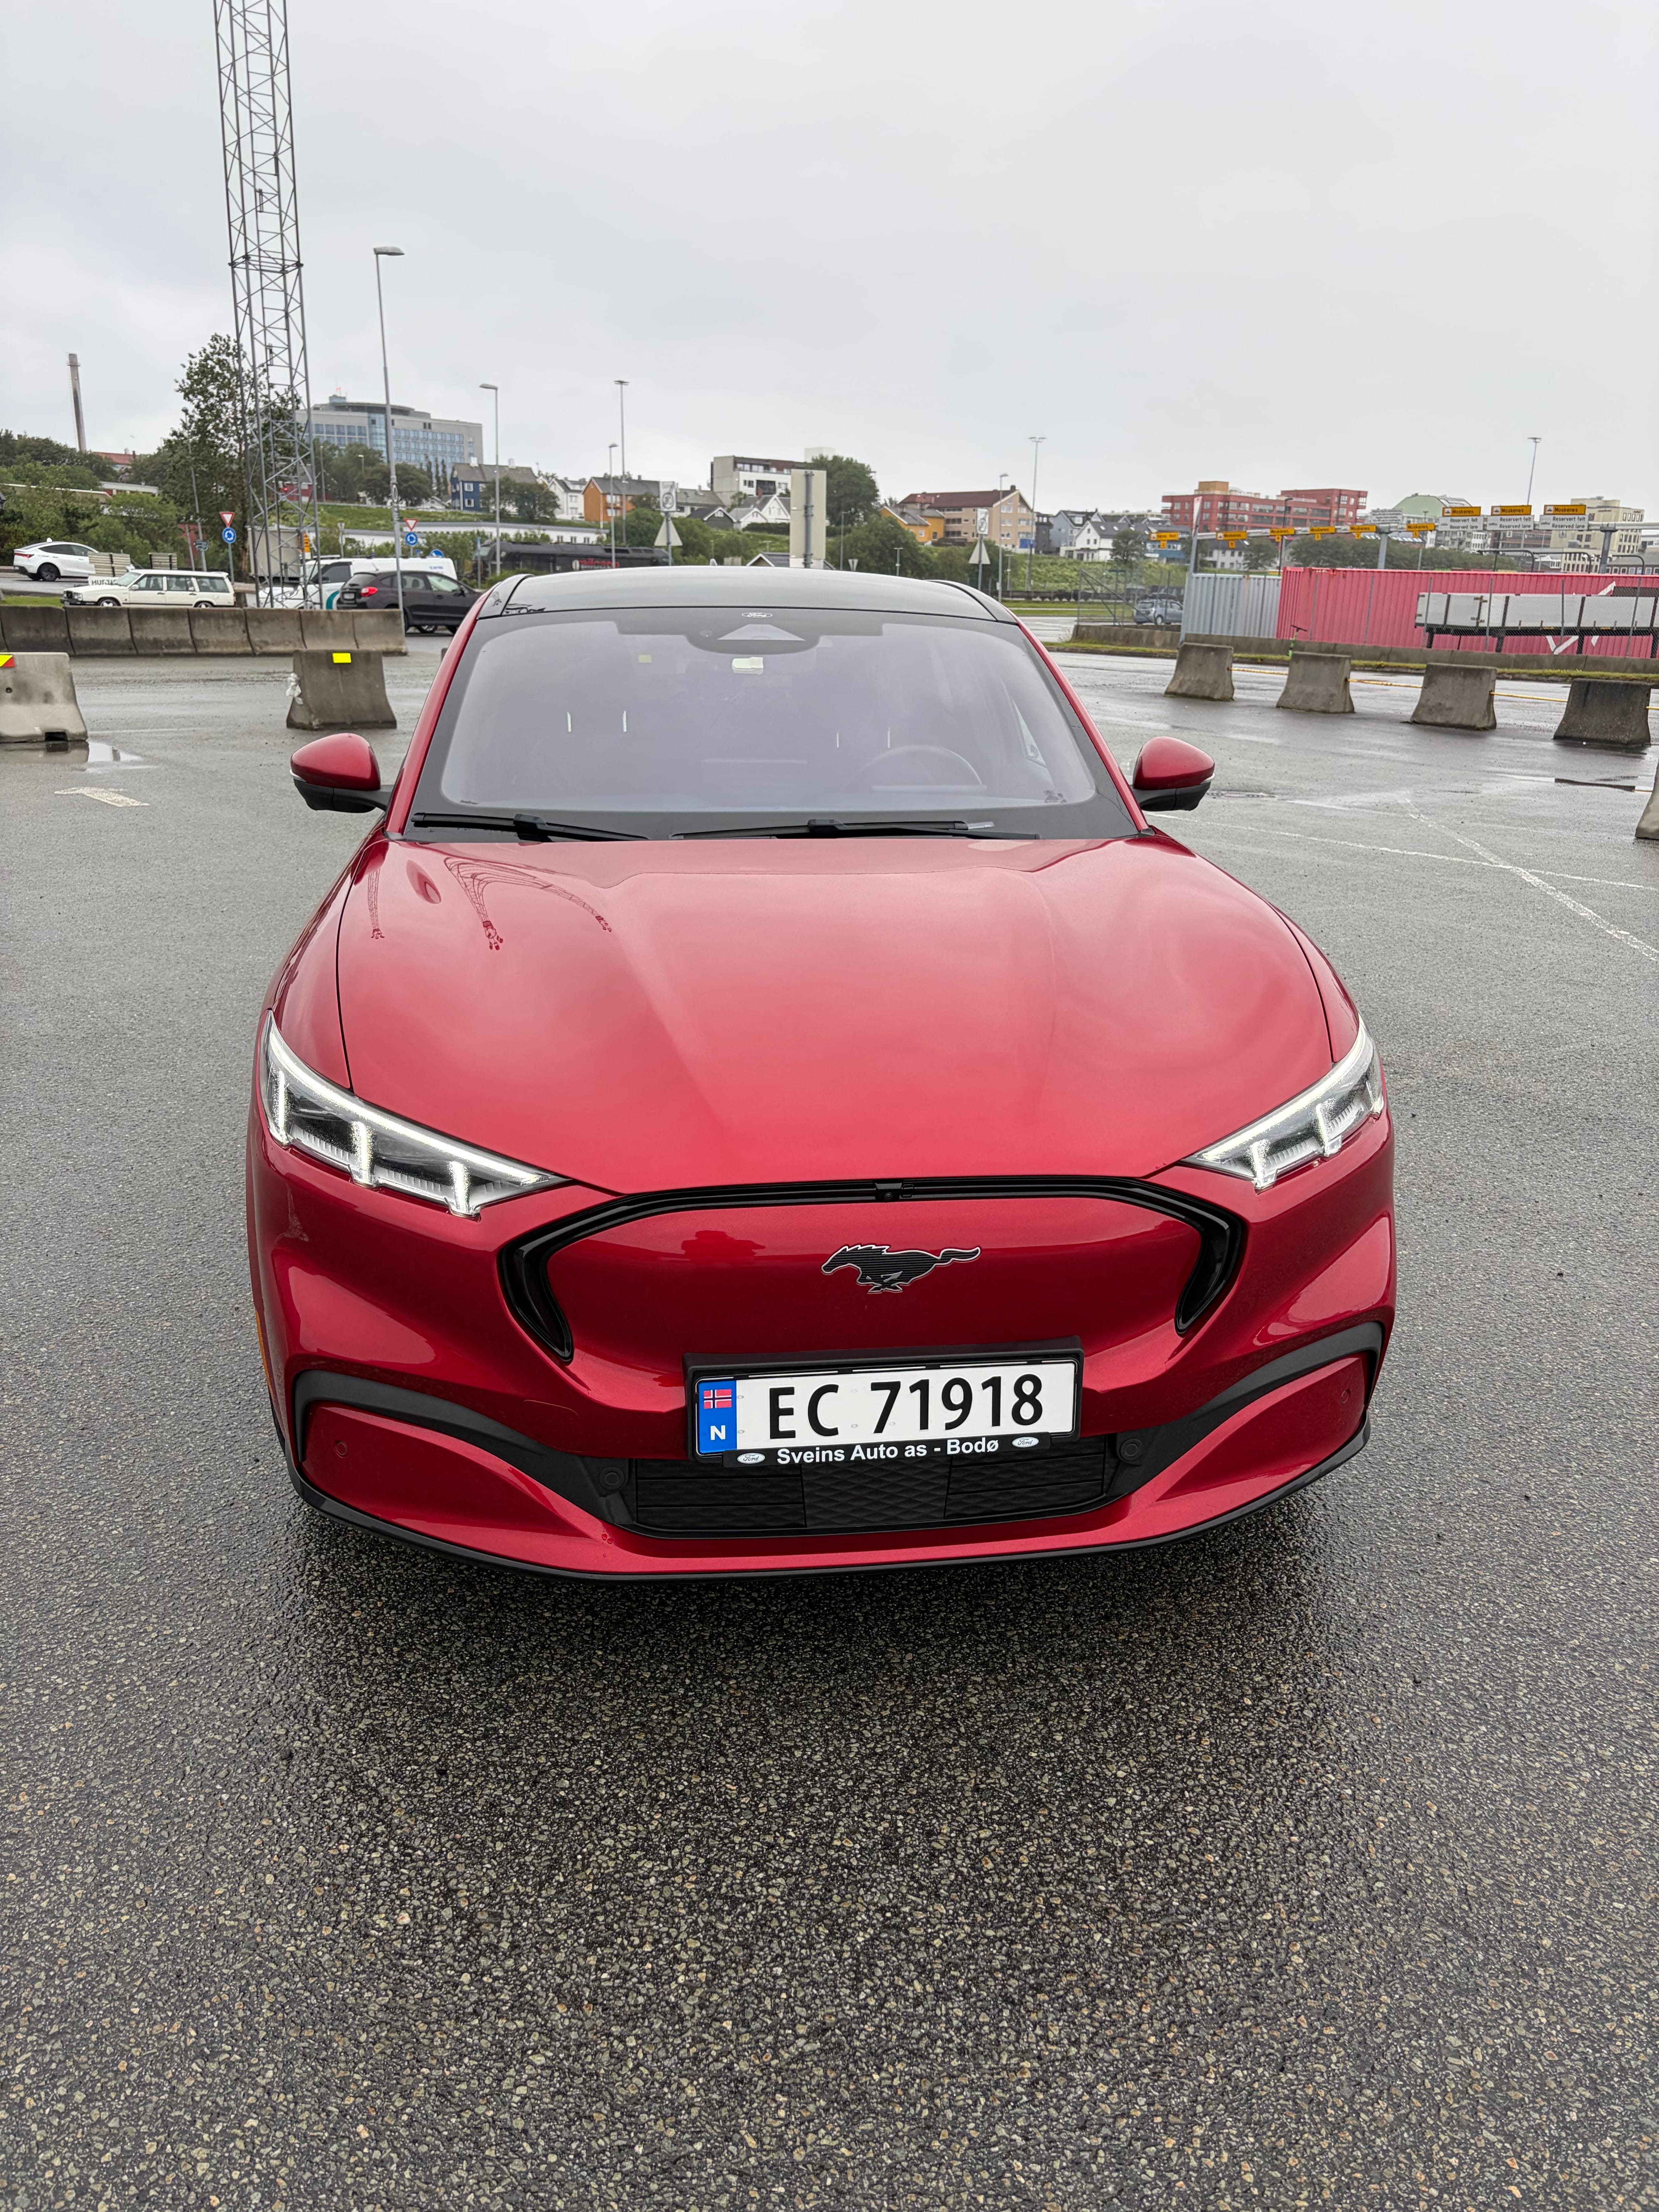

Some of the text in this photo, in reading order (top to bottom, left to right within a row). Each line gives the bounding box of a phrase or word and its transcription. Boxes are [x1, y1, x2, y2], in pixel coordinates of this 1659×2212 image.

[769, 1374, 1042, 1439] EC 71918
[710, 1425, 725, 1440] N
[777, 1447, 845, 1464] Sveins
[850, 1444, 898, 1460] Auto
[904, 1444, 927, 1457] as
[946, 1437, 999, 1455] Bodø
